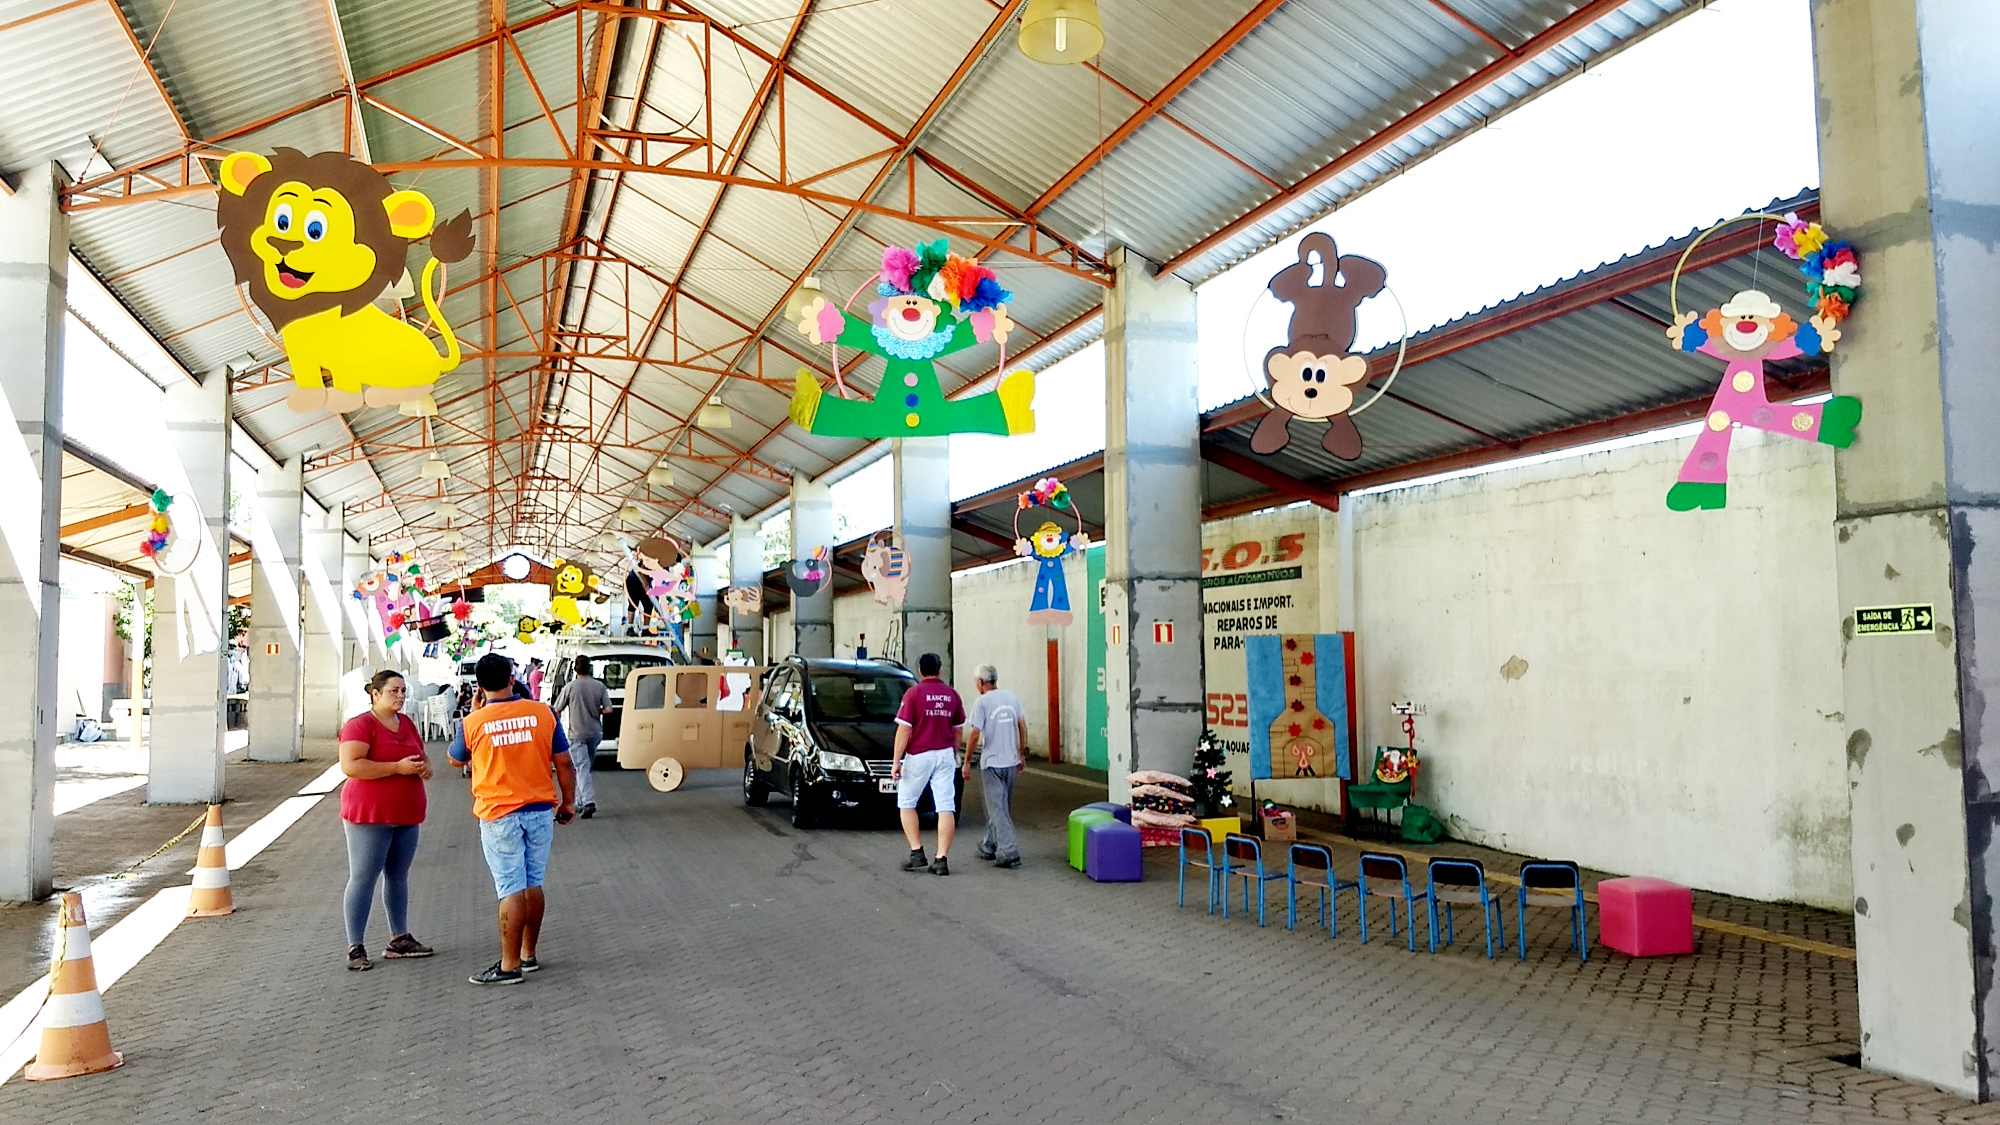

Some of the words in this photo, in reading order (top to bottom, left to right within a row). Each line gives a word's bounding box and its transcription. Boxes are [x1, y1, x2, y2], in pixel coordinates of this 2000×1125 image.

[1247, 598, 1252, 611] E
[1254, 595, 1294, 610] IMPORT.
[1217, 616, 1263, 632] REPAROS
[1265, 615, 1278, 630] DE
[1862, 611, 1882, 621] SAÍDA
[1883, 611, 1893, 620] DE
[1857, 622, 1899, 632] EMERGÊNCIA
[1206, 693, 1248, 728] 523
[484, 715, 537, 734] INSTITUTO
[491, 730, 532, 747] VITÓRIA
